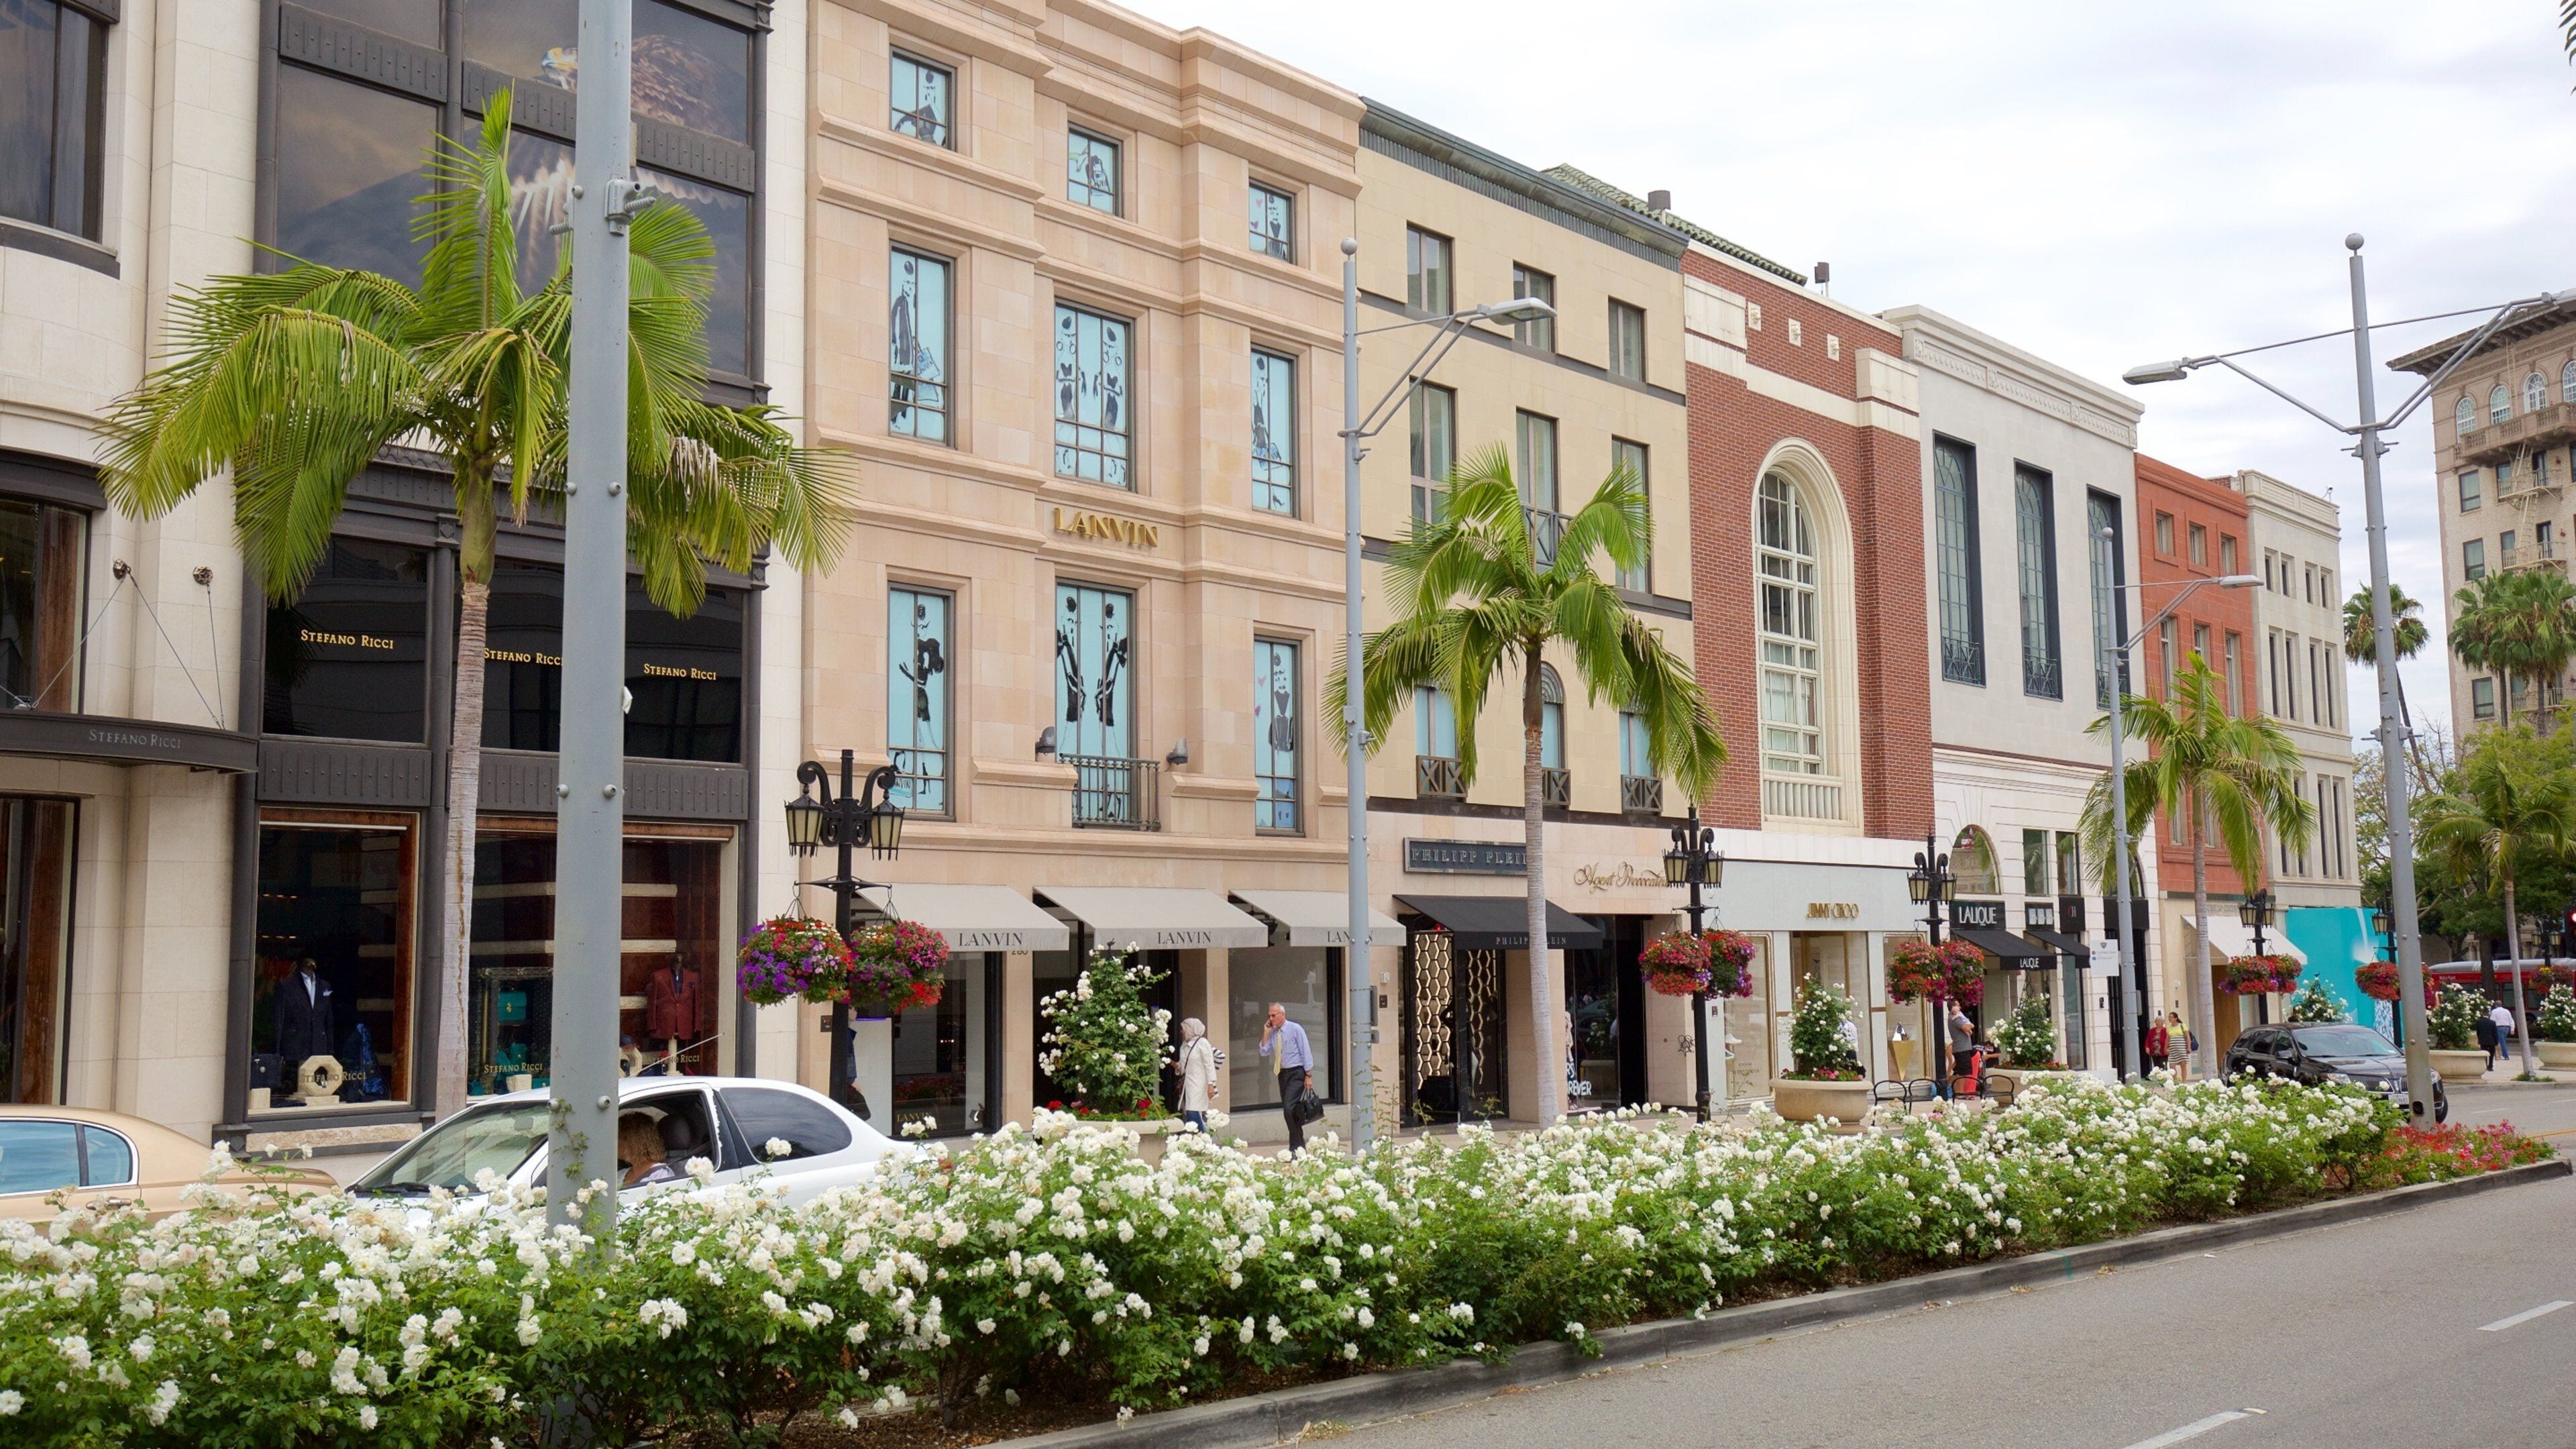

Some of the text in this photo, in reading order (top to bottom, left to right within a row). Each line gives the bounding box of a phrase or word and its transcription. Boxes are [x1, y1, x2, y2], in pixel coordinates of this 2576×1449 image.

[1053, 507, 1158, 548] LANVIN
[301, 629, 394, 649] STEFANO RICCI
[484, 648, 531, 663] STEFANO
[644, 663, 716, 680] STEFANO RICCI
[89, 729, 180, 749] STEFANO RICCI
[1411, 848, 1477, 863] PHILIPP
[1959, 906, 1997, 926] LALIQUE
[959, 932, 1023, 947] LANVIN
[1157, 931, 1212, 945] LANVIN
[1328, 931, 1373, 943] LANN
[1496, 936, 1529, 945] PHILIP
[2020, 958, 2039, 968] LALIQUE
[680, 1054, 700, 1063] RICCI
[484, 1062, 543, 1073] STEFANO RICCI
[341, 1071, 368, 1081] RICCI
[1567, 1080, 1592, 1095] REVER
